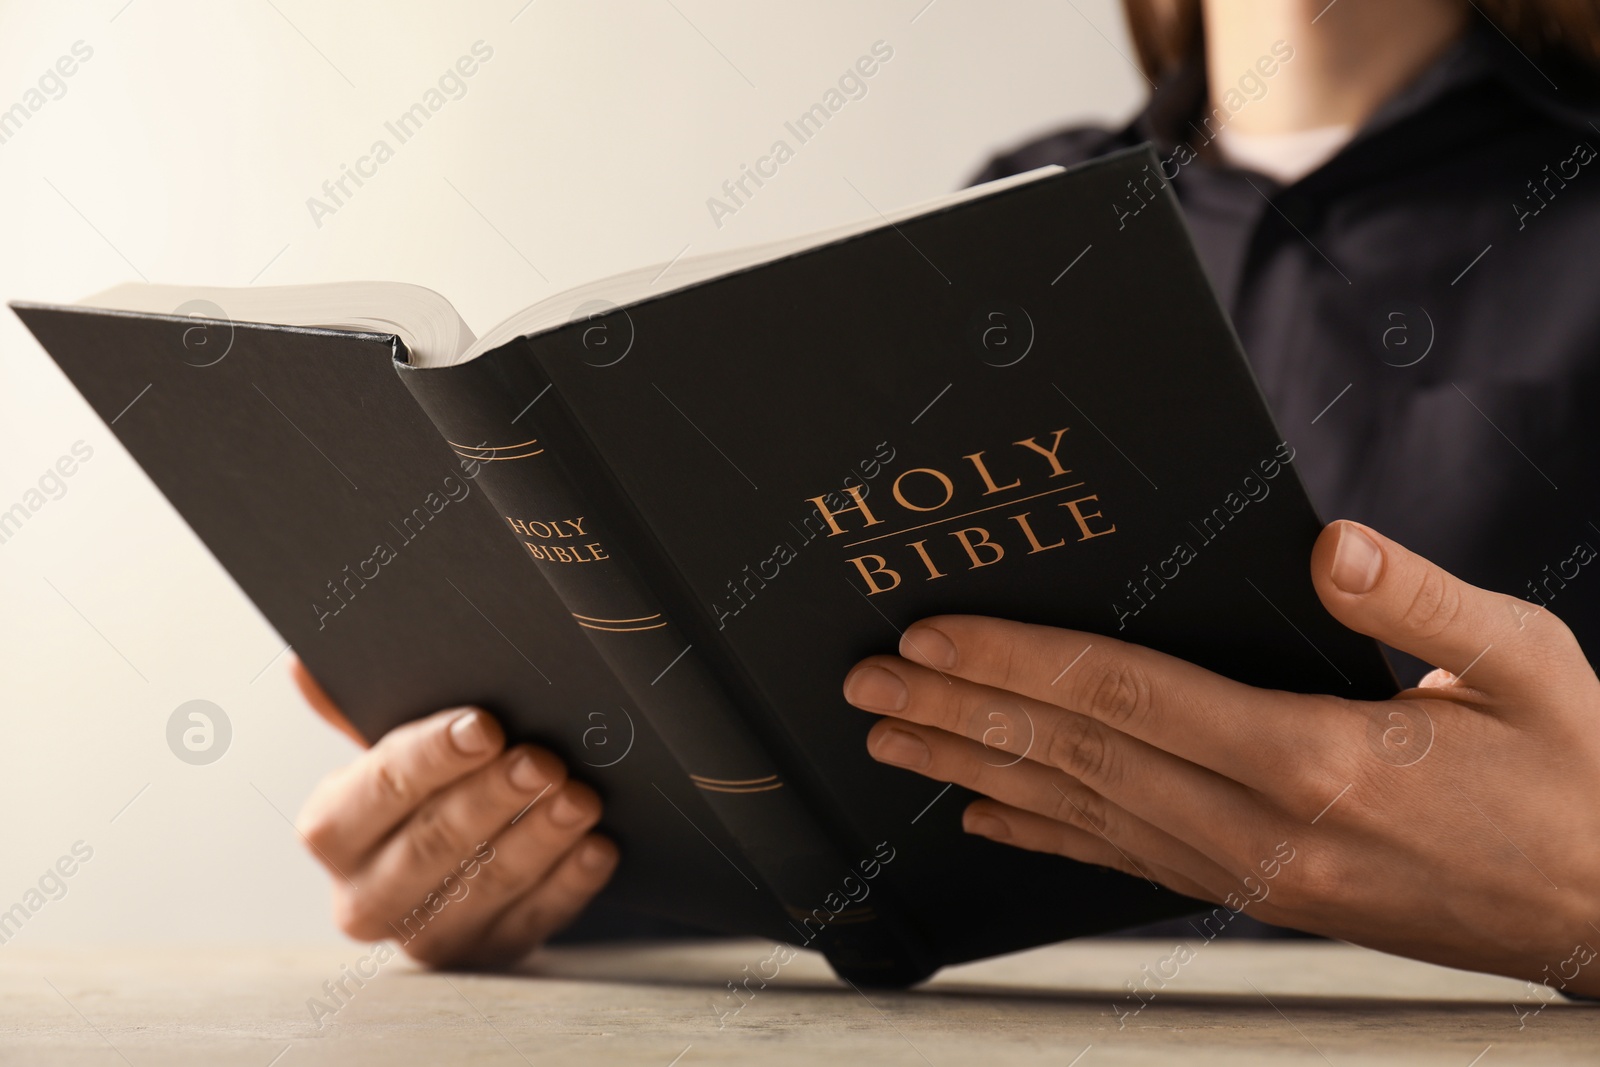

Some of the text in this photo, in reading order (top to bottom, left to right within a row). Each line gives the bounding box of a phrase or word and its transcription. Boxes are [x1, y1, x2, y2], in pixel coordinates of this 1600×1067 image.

[804, 427, 1072, 538] HOLY
[505, 516, 588, 539] HOLY
[524, 542, 610, 563] BIBLE
[844, 494, 1116, 597] BIBLE
